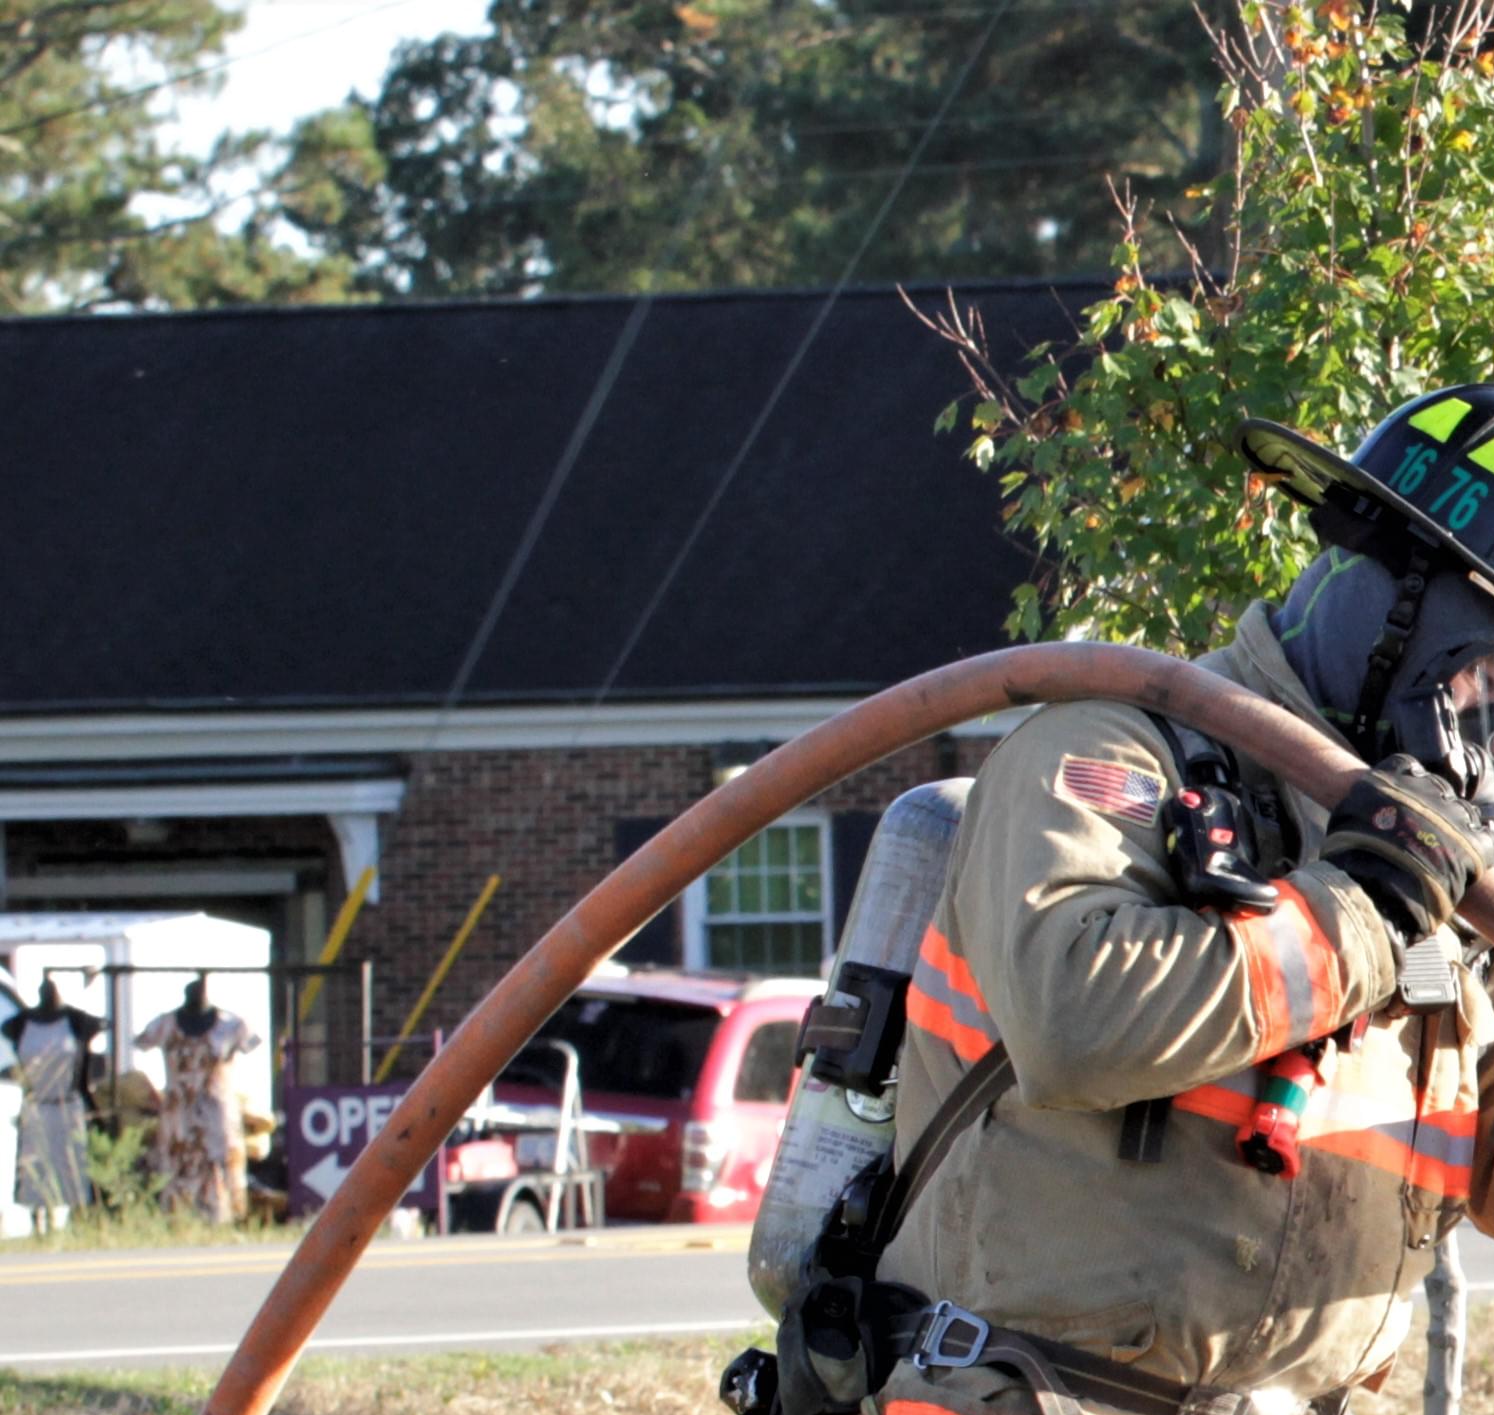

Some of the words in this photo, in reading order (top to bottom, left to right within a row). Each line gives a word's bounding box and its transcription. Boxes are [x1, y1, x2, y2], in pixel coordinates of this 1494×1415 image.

[1387, 443, 1438, 496] 16
[1429, 465, 1489, 530] 76
[301, 1096, 408, 1147] OPE
